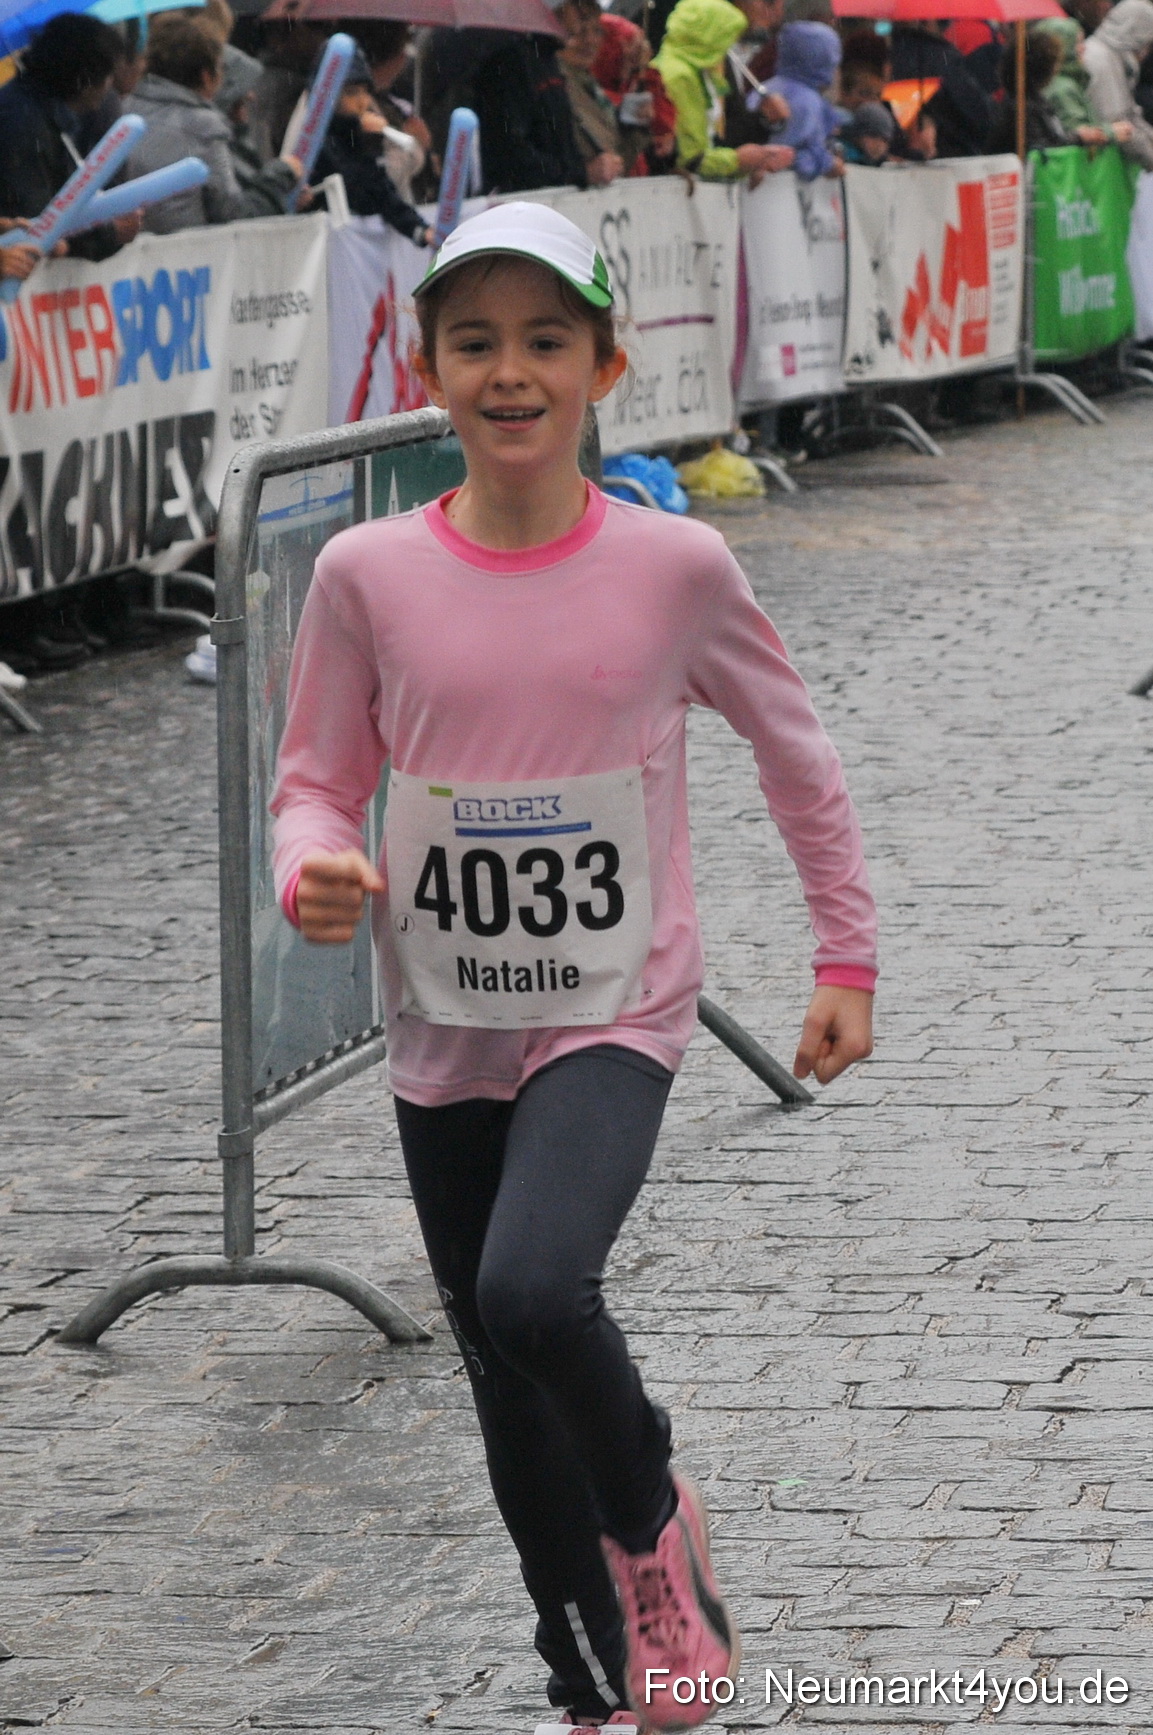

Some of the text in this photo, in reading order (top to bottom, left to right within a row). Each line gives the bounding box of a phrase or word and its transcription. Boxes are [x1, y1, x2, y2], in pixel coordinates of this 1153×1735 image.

[6, 266, 212, 415] INTERSPORT
[454, 795, 562, 822] BOCK
[413, 840, 625, 938] 4033
[456, 955, 581, 994] Natalie
